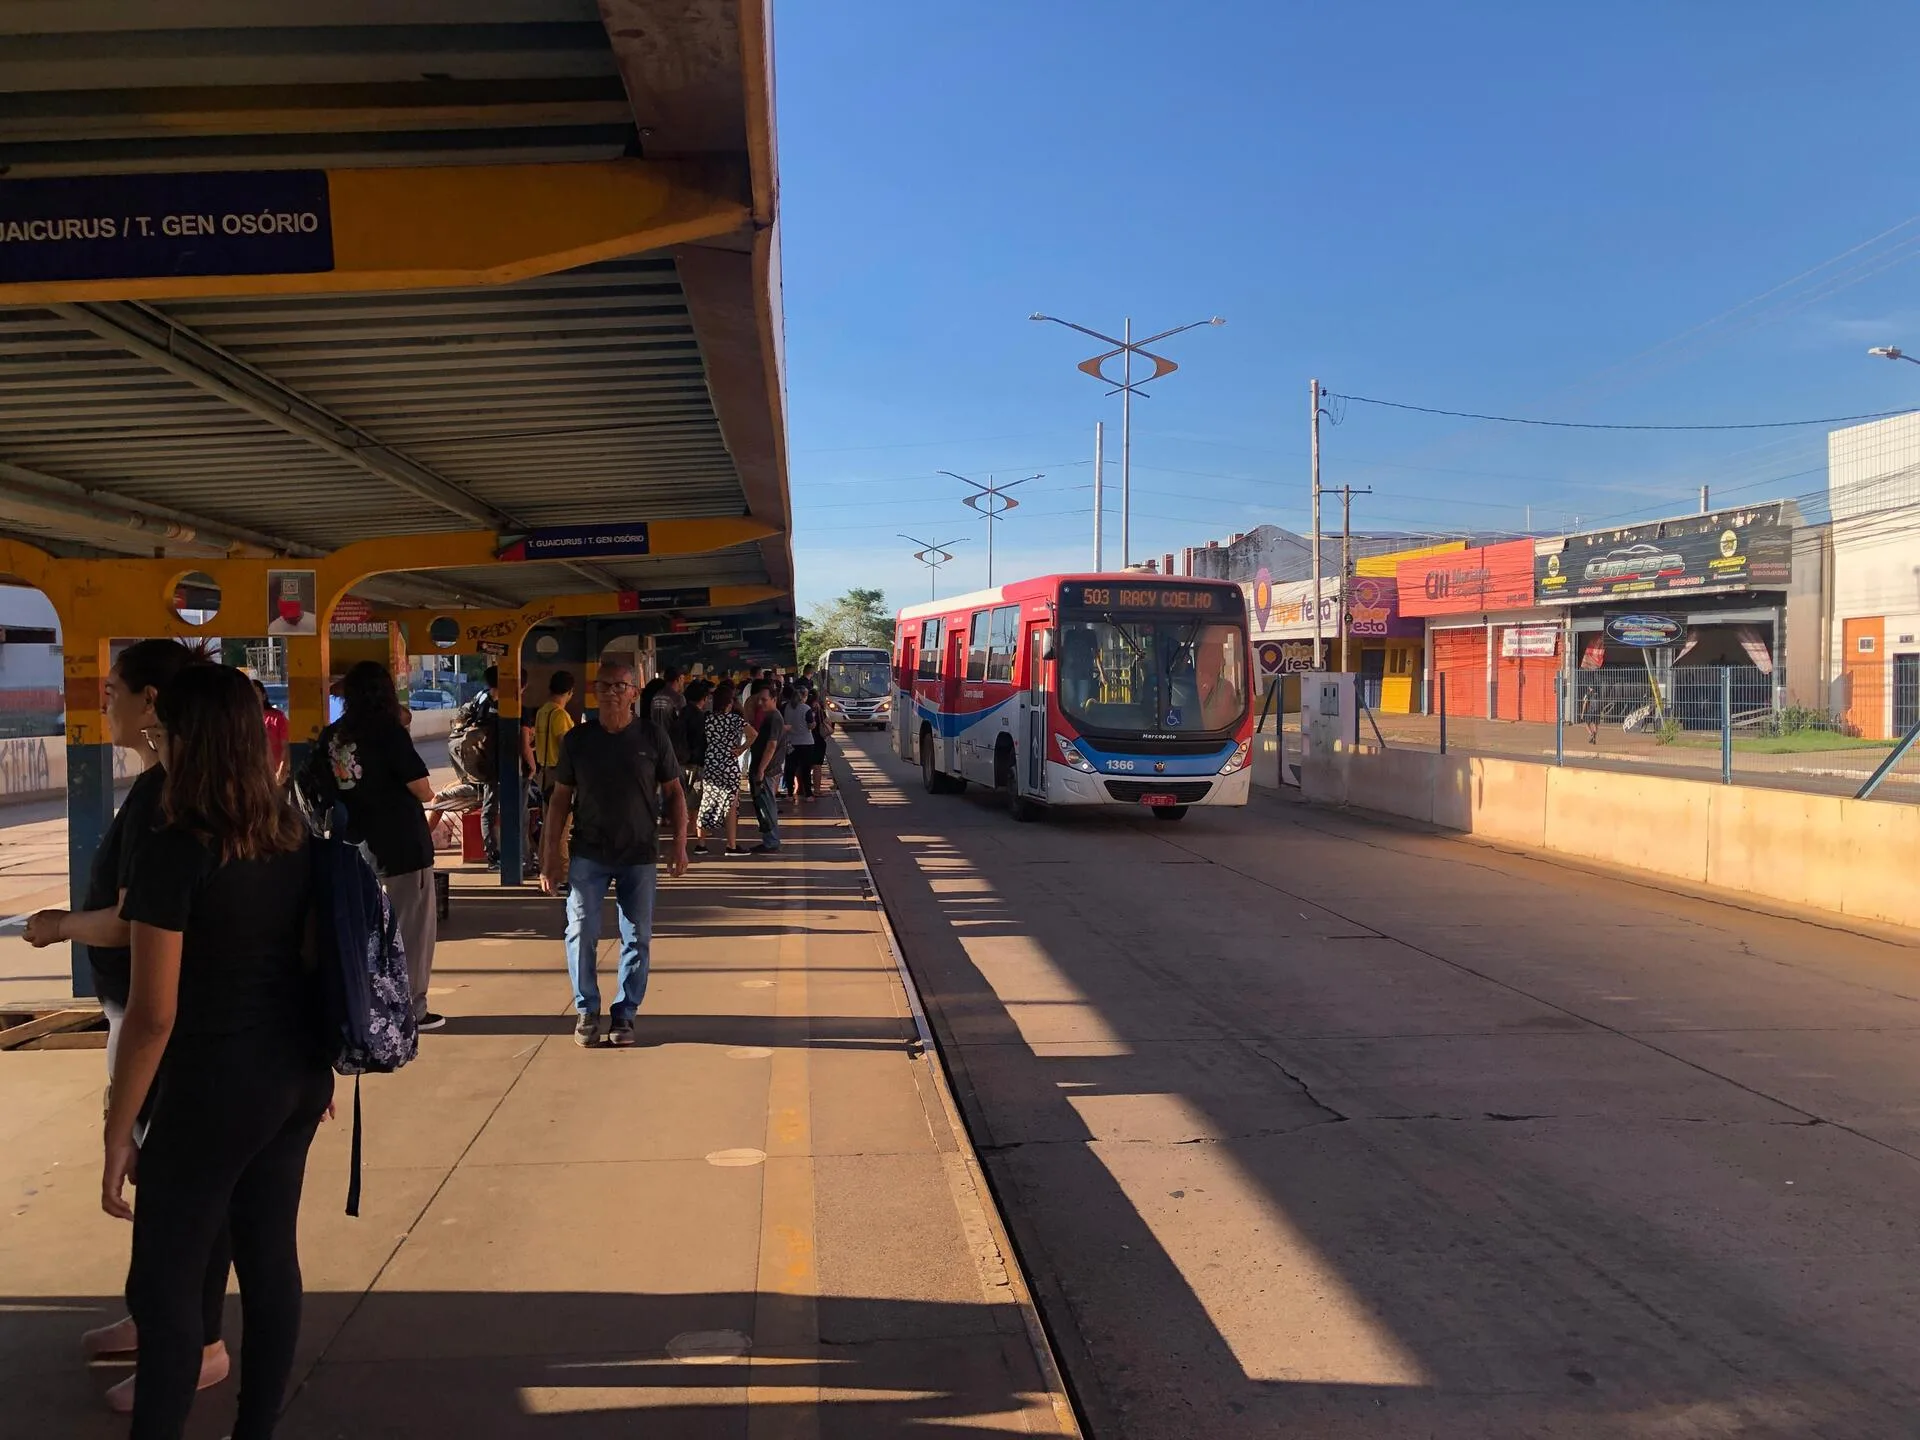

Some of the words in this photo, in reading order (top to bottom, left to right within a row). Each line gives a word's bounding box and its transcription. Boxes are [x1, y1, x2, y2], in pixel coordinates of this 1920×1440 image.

[123, 216, 129, 237] /
[136, 216, 155, 237] T.
[162, 214, 215, 236] GEN
[222, 208, 318, 235] OSÓRIO
[536, 537, 582, 548] GUAICURUS
[596, 535, 612, 544] GEN
[614, 533, 644, 543] OSÓRIO
[1083, 588, 1110, 605] 503
[1119, 590, 1157, 607] IRACY
[1161, 591, 1212, 608] COELHO
[1301, 594, 1331, 621] fea
[330, 622, 356, 633] CAMPO
[357, 622, 388, 633] GRANDE
[1353, 618, 1386, 632] esta
[1142, 733, 1177, 741] Marcopolo
[1106, 759, 1134, 770] 1366
